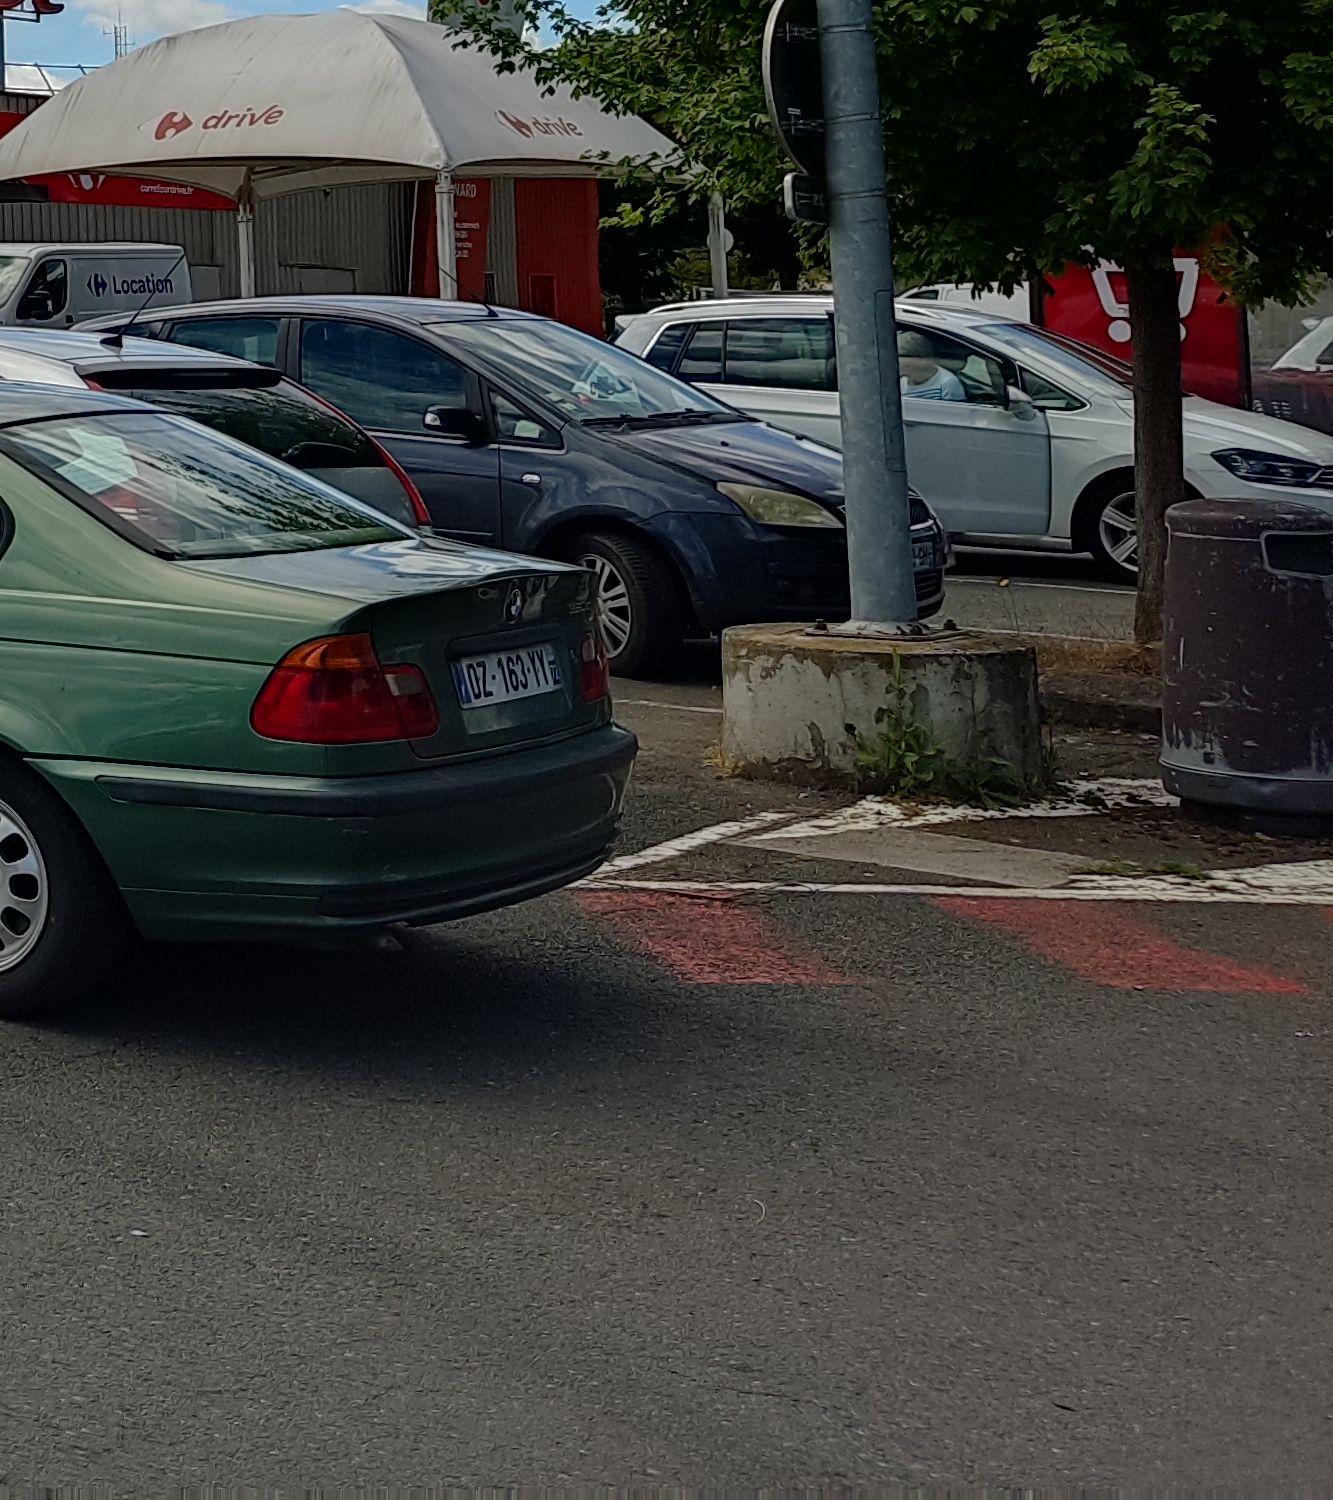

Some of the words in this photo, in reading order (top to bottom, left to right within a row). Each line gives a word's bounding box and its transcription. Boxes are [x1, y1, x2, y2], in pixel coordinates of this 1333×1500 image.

[201, 103, 284, 131] drive
[531, 114, 584, 138] drive
[112, 273, 174, 294] Location
